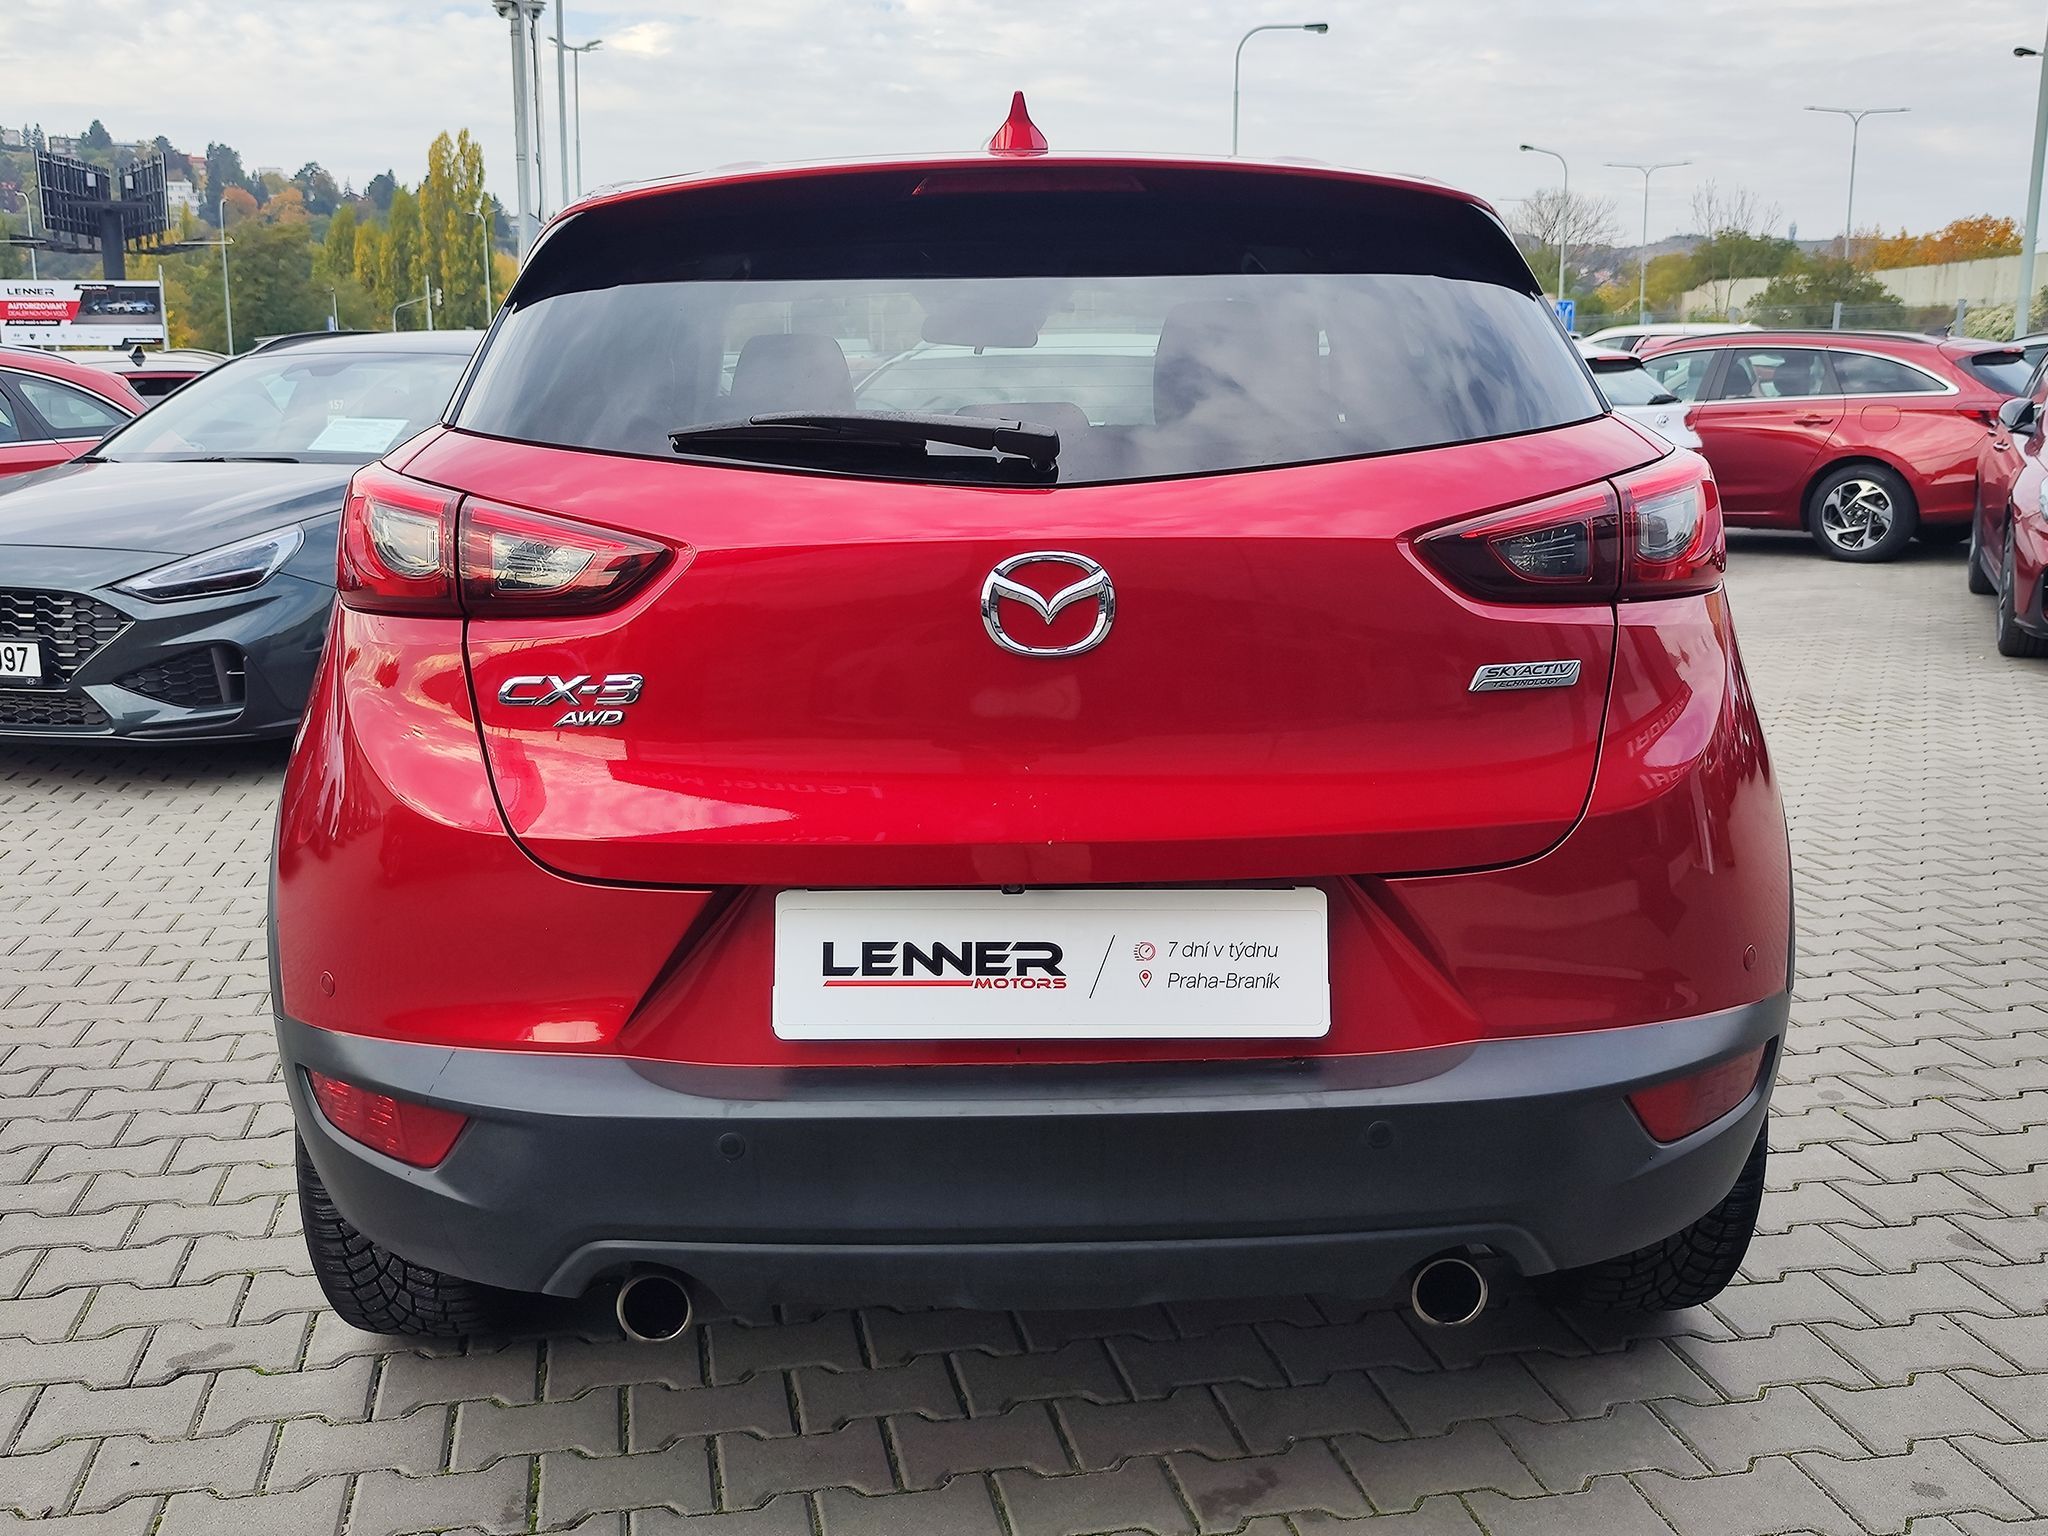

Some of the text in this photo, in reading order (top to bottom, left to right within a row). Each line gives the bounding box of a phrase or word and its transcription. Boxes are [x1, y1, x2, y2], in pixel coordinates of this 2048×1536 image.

[7, 287, 55, 296] LENNER
[1485, 662, 1572, 678] SKYACTIV
[497, 673, 645, 707] CX-3
[1493, 677, 1563, 688] TECHNOLOGY
[552, 709, 625, 728] AWD
[822, 941, 1068, 977] LENNER
[1168, 940, 1279, 962] 7 dní v týdnu
[973, 977, 1068, 989] MOTORS
[1167, 972, 1281, 989] Praha-Braník
